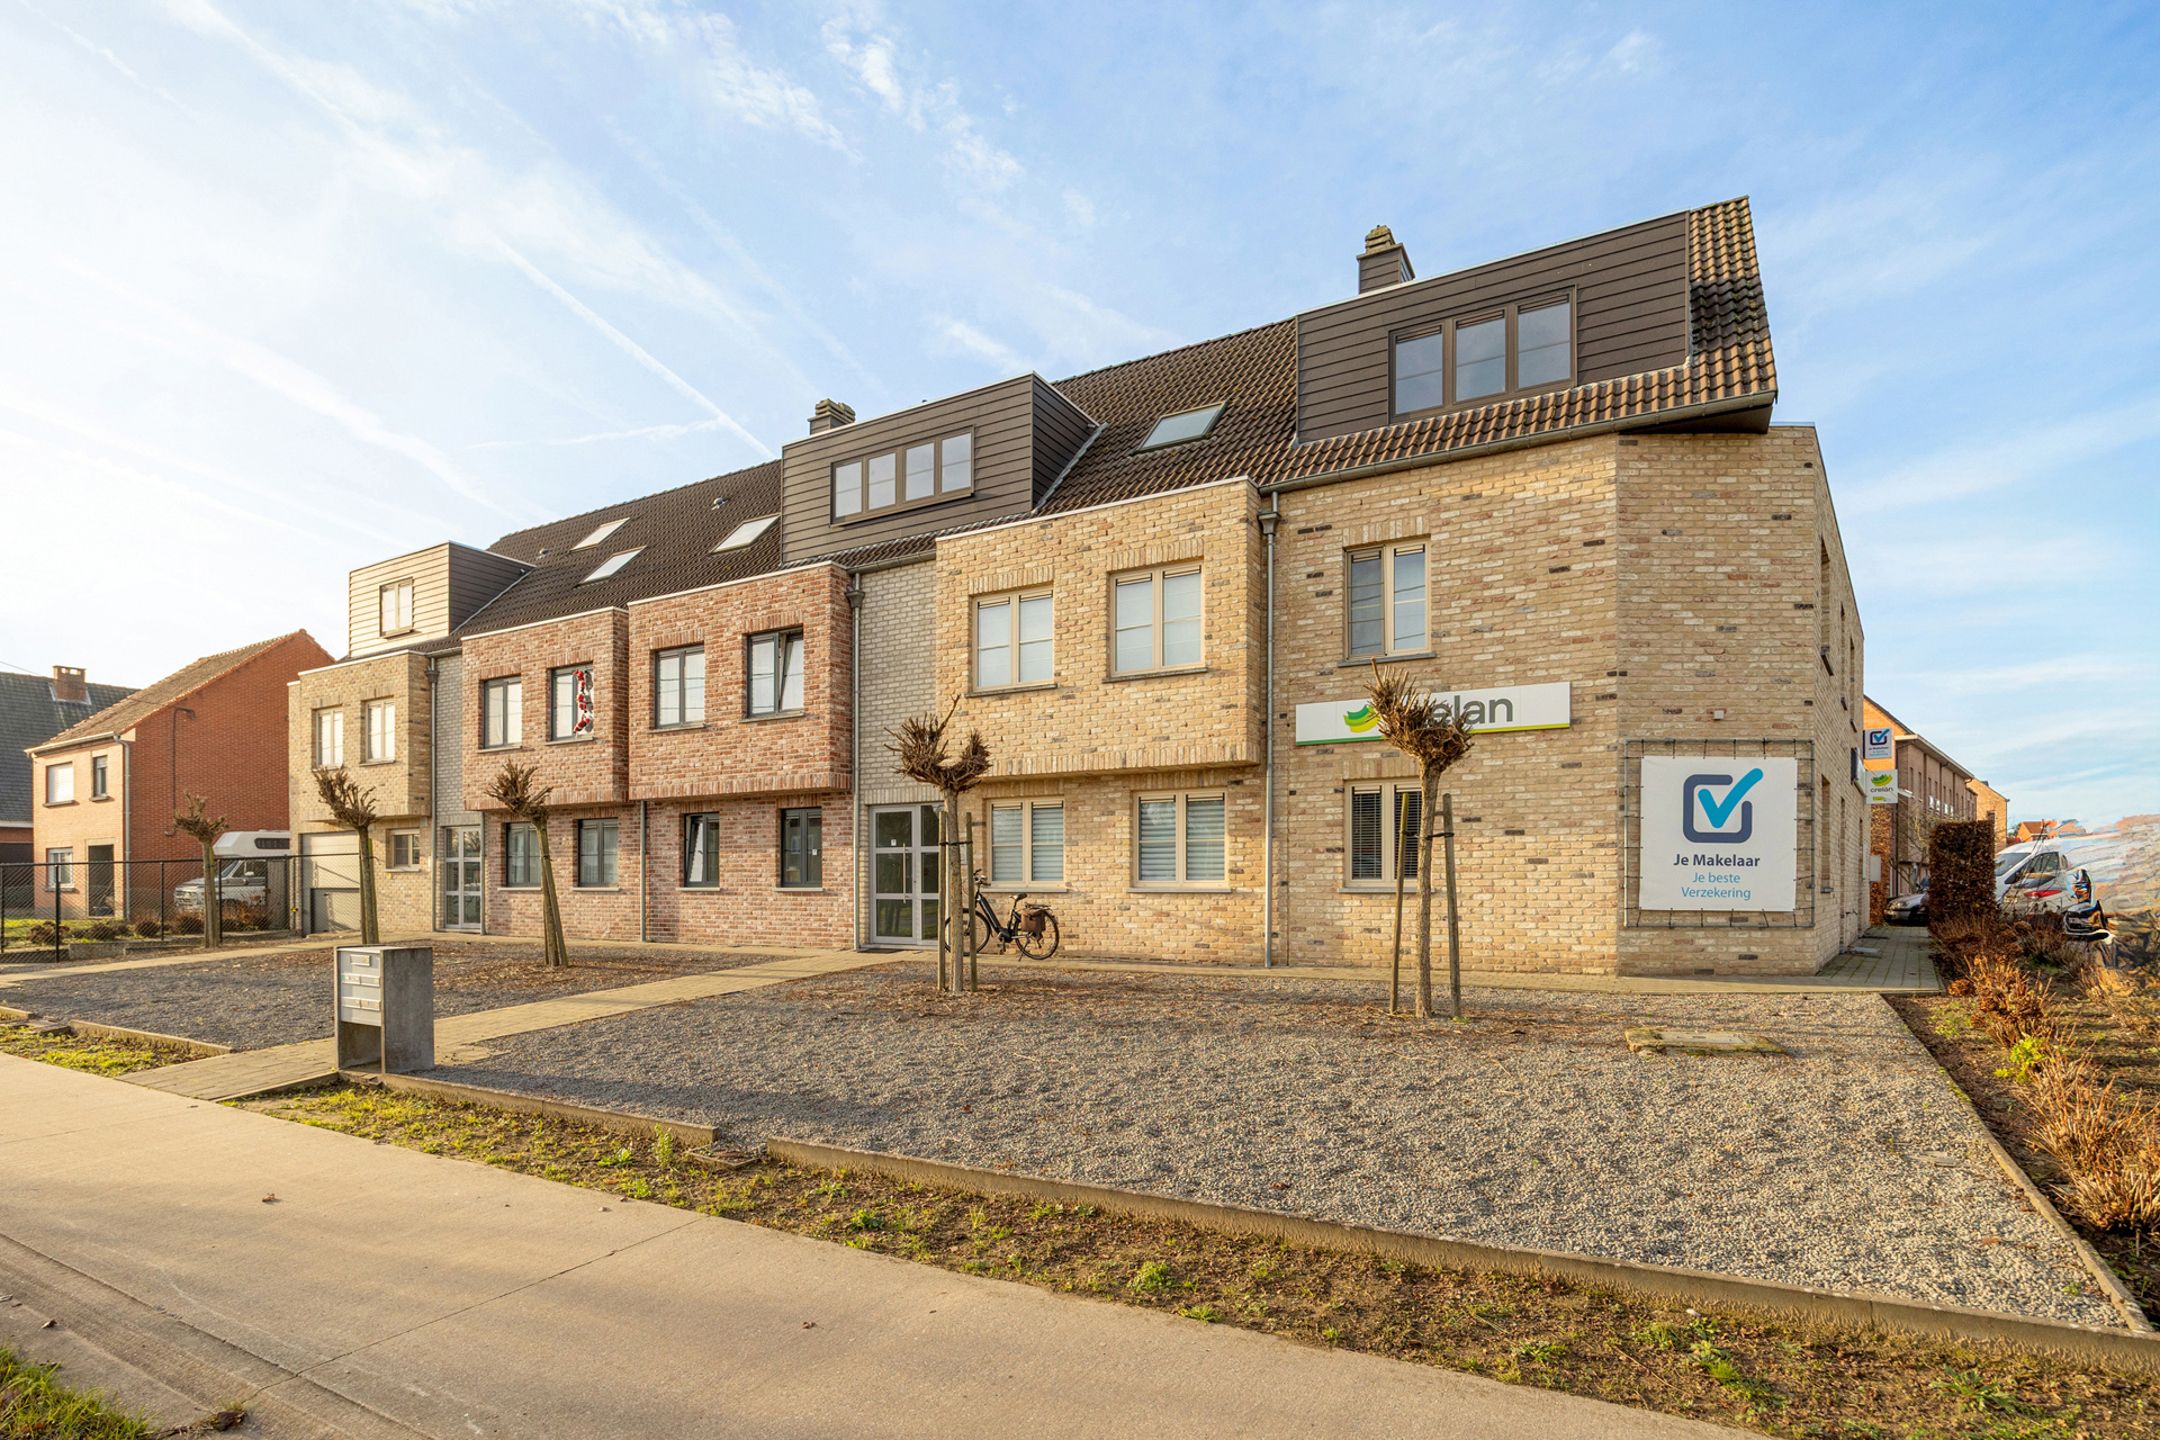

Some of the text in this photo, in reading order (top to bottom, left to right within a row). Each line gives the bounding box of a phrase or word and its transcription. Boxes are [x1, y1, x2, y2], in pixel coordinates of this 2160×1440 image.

[1429, 695, 1513, 726] elan
[1673, 854, 1760, 867] Je Makelaar
[1692, 872, 1741, 883] Je beste
[1681, 887, 1751, 901] Verzekering
